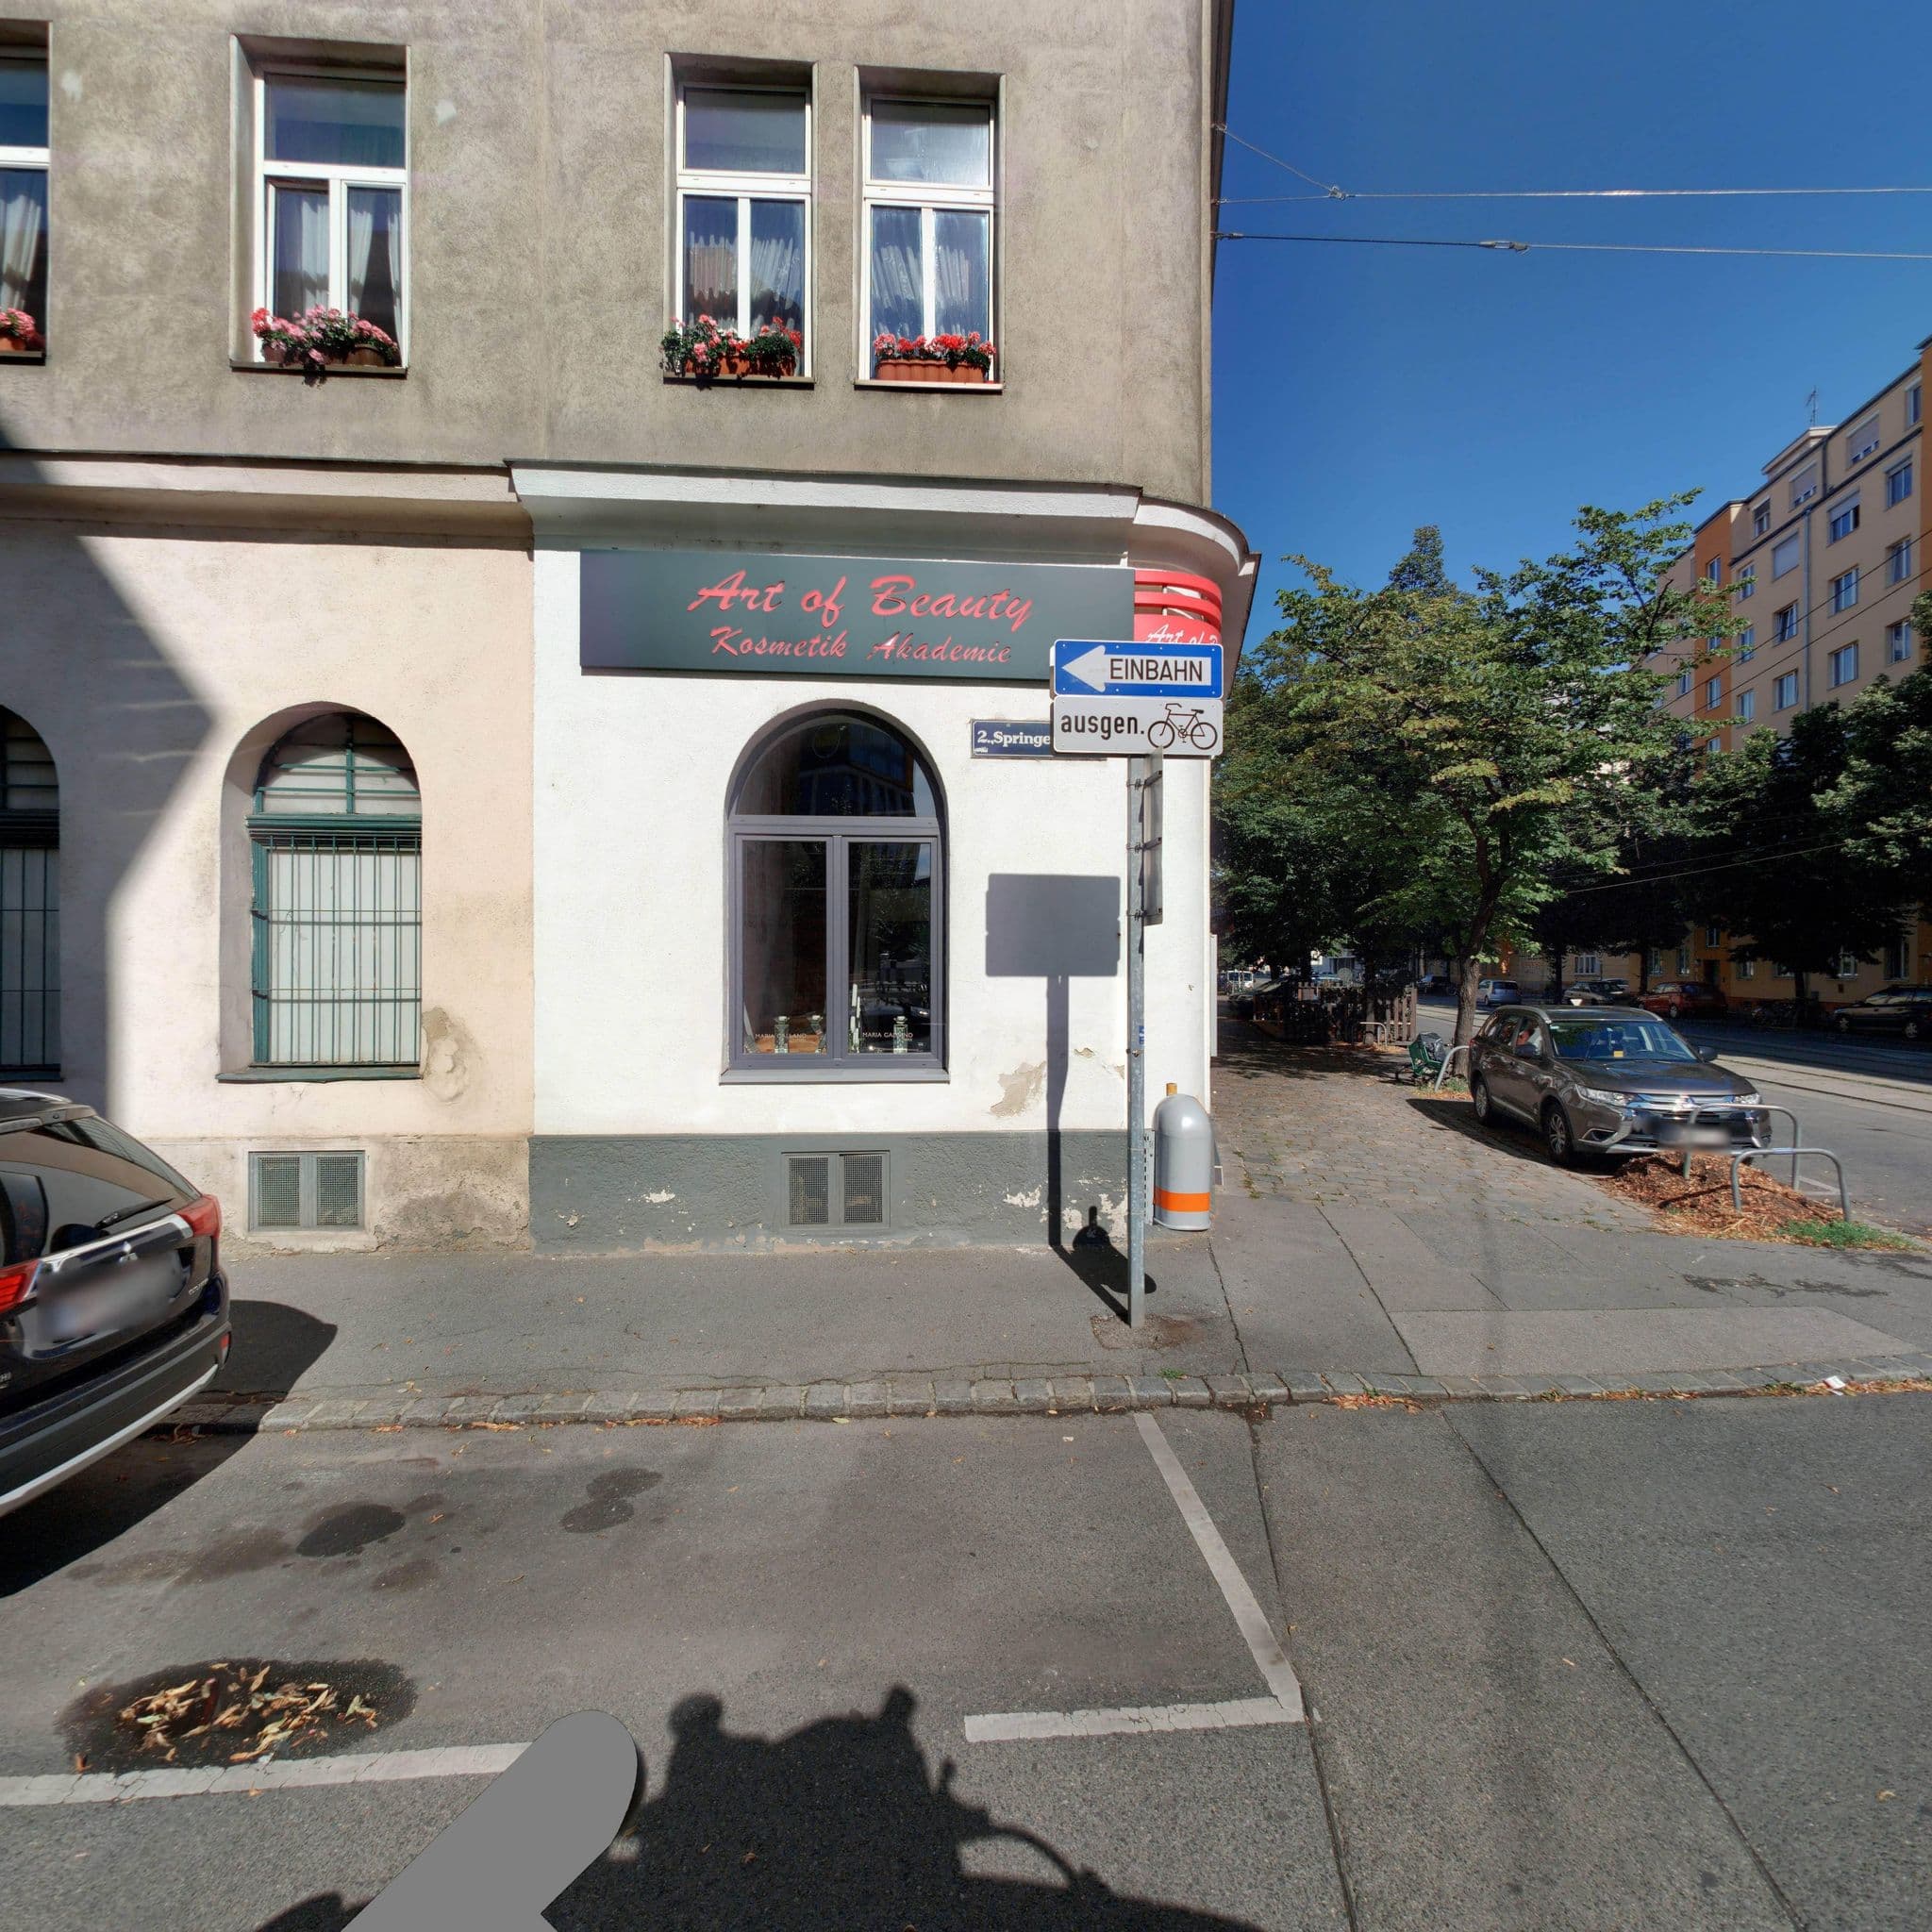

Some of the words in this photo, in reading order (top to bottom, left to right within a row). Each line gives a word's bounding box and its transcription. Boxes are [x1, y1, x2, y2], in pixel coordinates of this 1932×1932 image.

[687, 570, 785, 611] Art
[801, 575, 847, 628] of
[870, 575, 1033, 632] Beauty
[709, 625, 848, 657] Kosmetik
[867, 632, 1012, 663] Akademie
[1145, 624, 1184, 643] Art
[1109, 658, 1203, 682] EINBAHN
[1060, 714, 1144, 740] ausgen.
